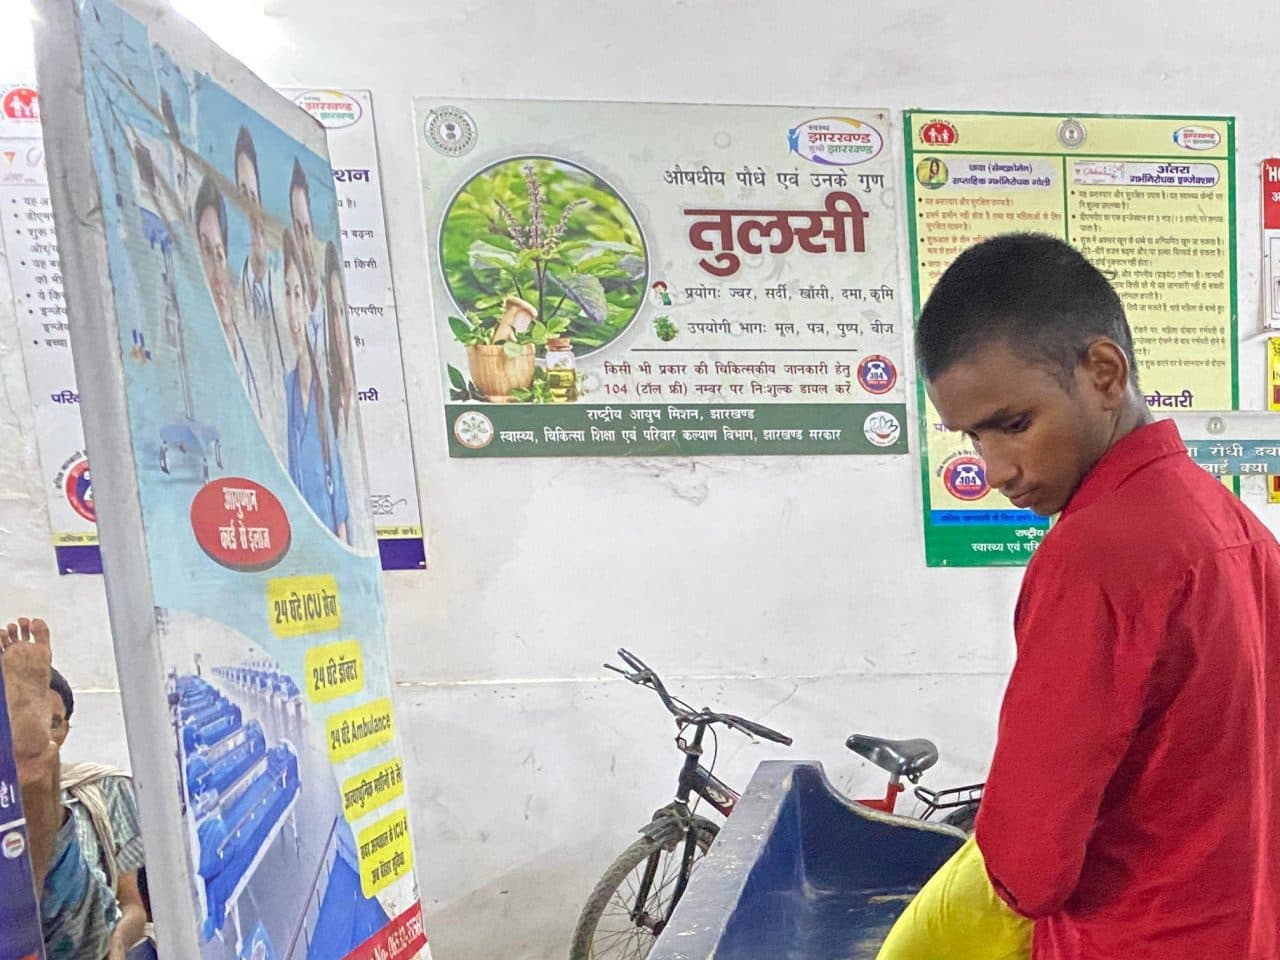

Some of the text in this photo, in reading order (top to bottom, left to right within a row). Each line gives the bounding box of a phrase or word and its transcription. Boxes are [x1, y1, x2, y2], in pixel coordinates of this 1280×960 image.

[664, 164, 885, 193] औषधीय पौधे एवं उनके गुण
[684, 191, 869, 277] तुलसी
[870, 284, 894, 302] कृमि
[688, 319, 731, 334] उपयोगी
[871, 320, 894, 334] बीज
[604, 361, 851, 378] किसी भी प्रकार की चिकित्सकीय जानकारी हेतु
[603, 383, 628, 394] 104
[729, 384, 744, 395] पर
[800, 384, 828, 395] डायल
[834, 380, 852, 395] करें
[586, 407, 755, 423] राष्ट्रीय आयुष मिशन, झारखण्ड
[544, 426, 585, 442] चिकित्सा
[591, 426, 616, 442] शिक्षा
[621, 426, 637, 444] एवं
[643, 426, 677, 442] परिवार
[682, 430, 718, 442] कल्याण
[722, 426, 758, 442] विभाग,
[762, 430, 803, 441] झारखण्ड
[809, 430, 841, 441] सरकार
[1209, 443, 1243, 457] रोधी
[1240, 463, 1268, 473] क्या
[1006, 542, 1020, 553] एवं
[274, 600, 288, 624] 24
[304, 593, 322, 621] ICU
[313, 668, 326, 691] 24
[330, 728, 341, 750] 24
[351, 711, 391, 743] Ambulance
